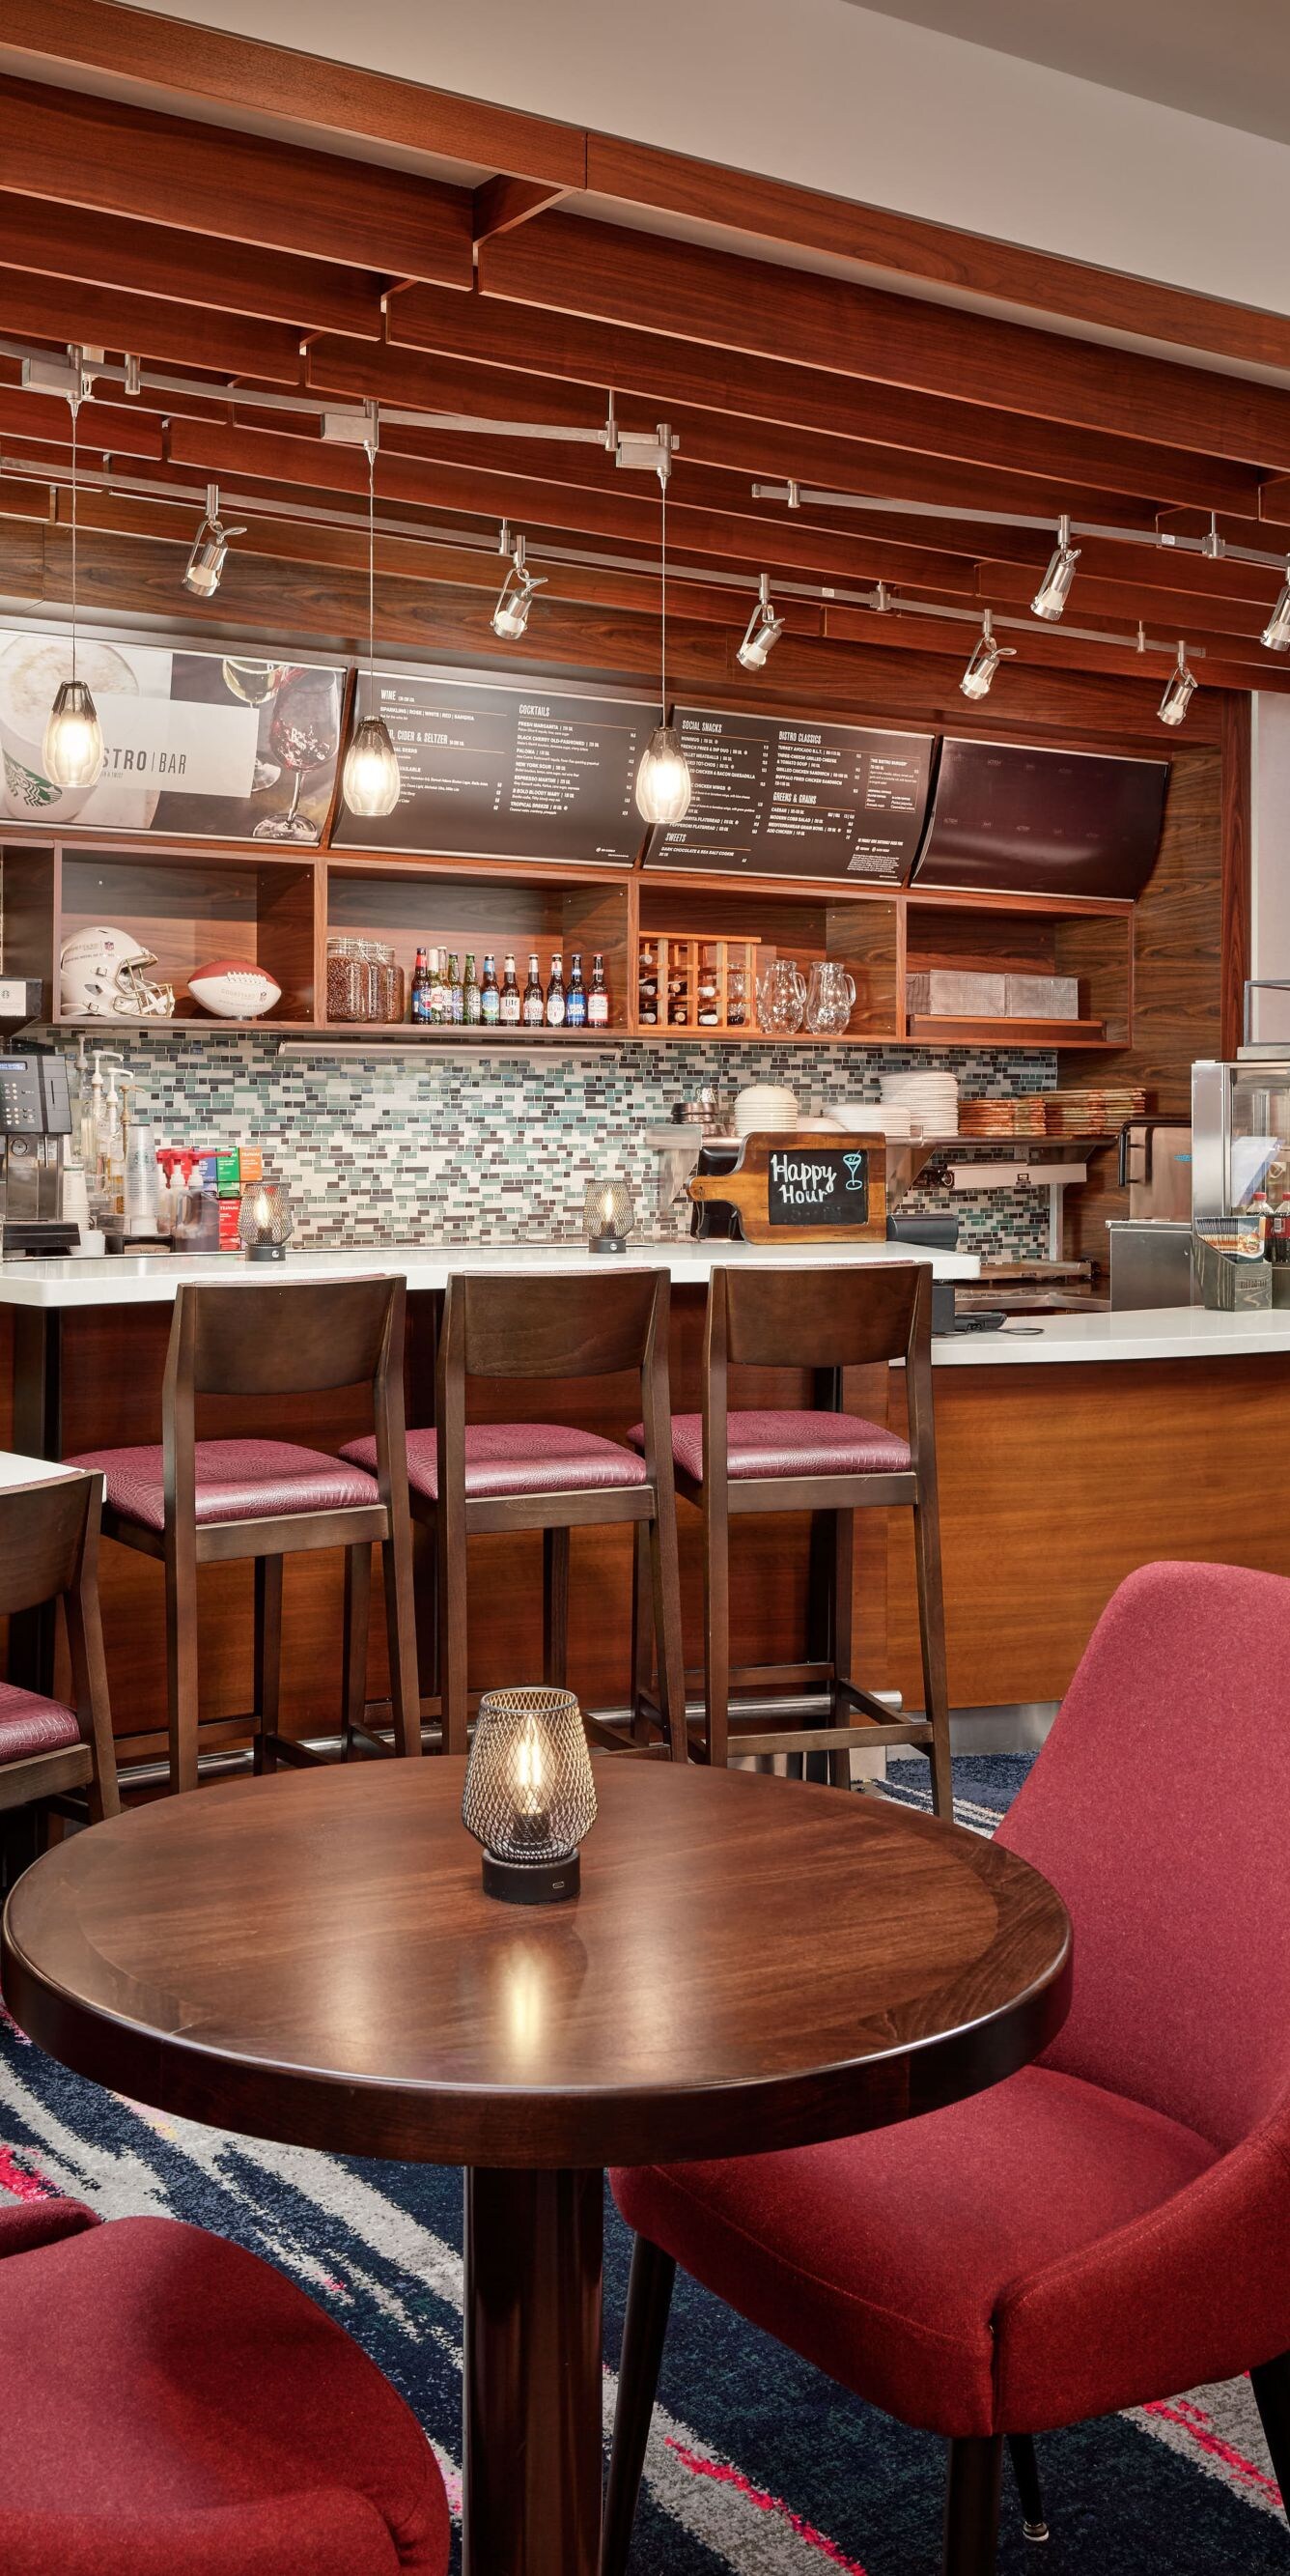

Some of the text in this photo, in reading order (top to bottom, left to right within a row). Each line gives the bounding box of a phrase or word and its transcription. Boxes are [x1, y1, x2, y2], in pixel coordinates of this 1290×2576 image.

[380, 689, 397, 701] WINE
[519, 704, 550, 717] COCKTAILS
[682, 720, 722, 733] SOCIAL SNACKS
[397, 729, 415, 741] CIDER
[416, 732, 423, 742] &
[424, 732, 448, 745] SELTZER
[778, 730, 822, 745] BISTRO CLASSICS
[102, 748, 186, 775] STRO BAR
[772, 791, 817, 805] GREENS & GRAINS
[665, 833, 687, 842] SWEETS
[771, 1154, 837, 1193] Happy
[778, 1184, 827, 1203] Hour
